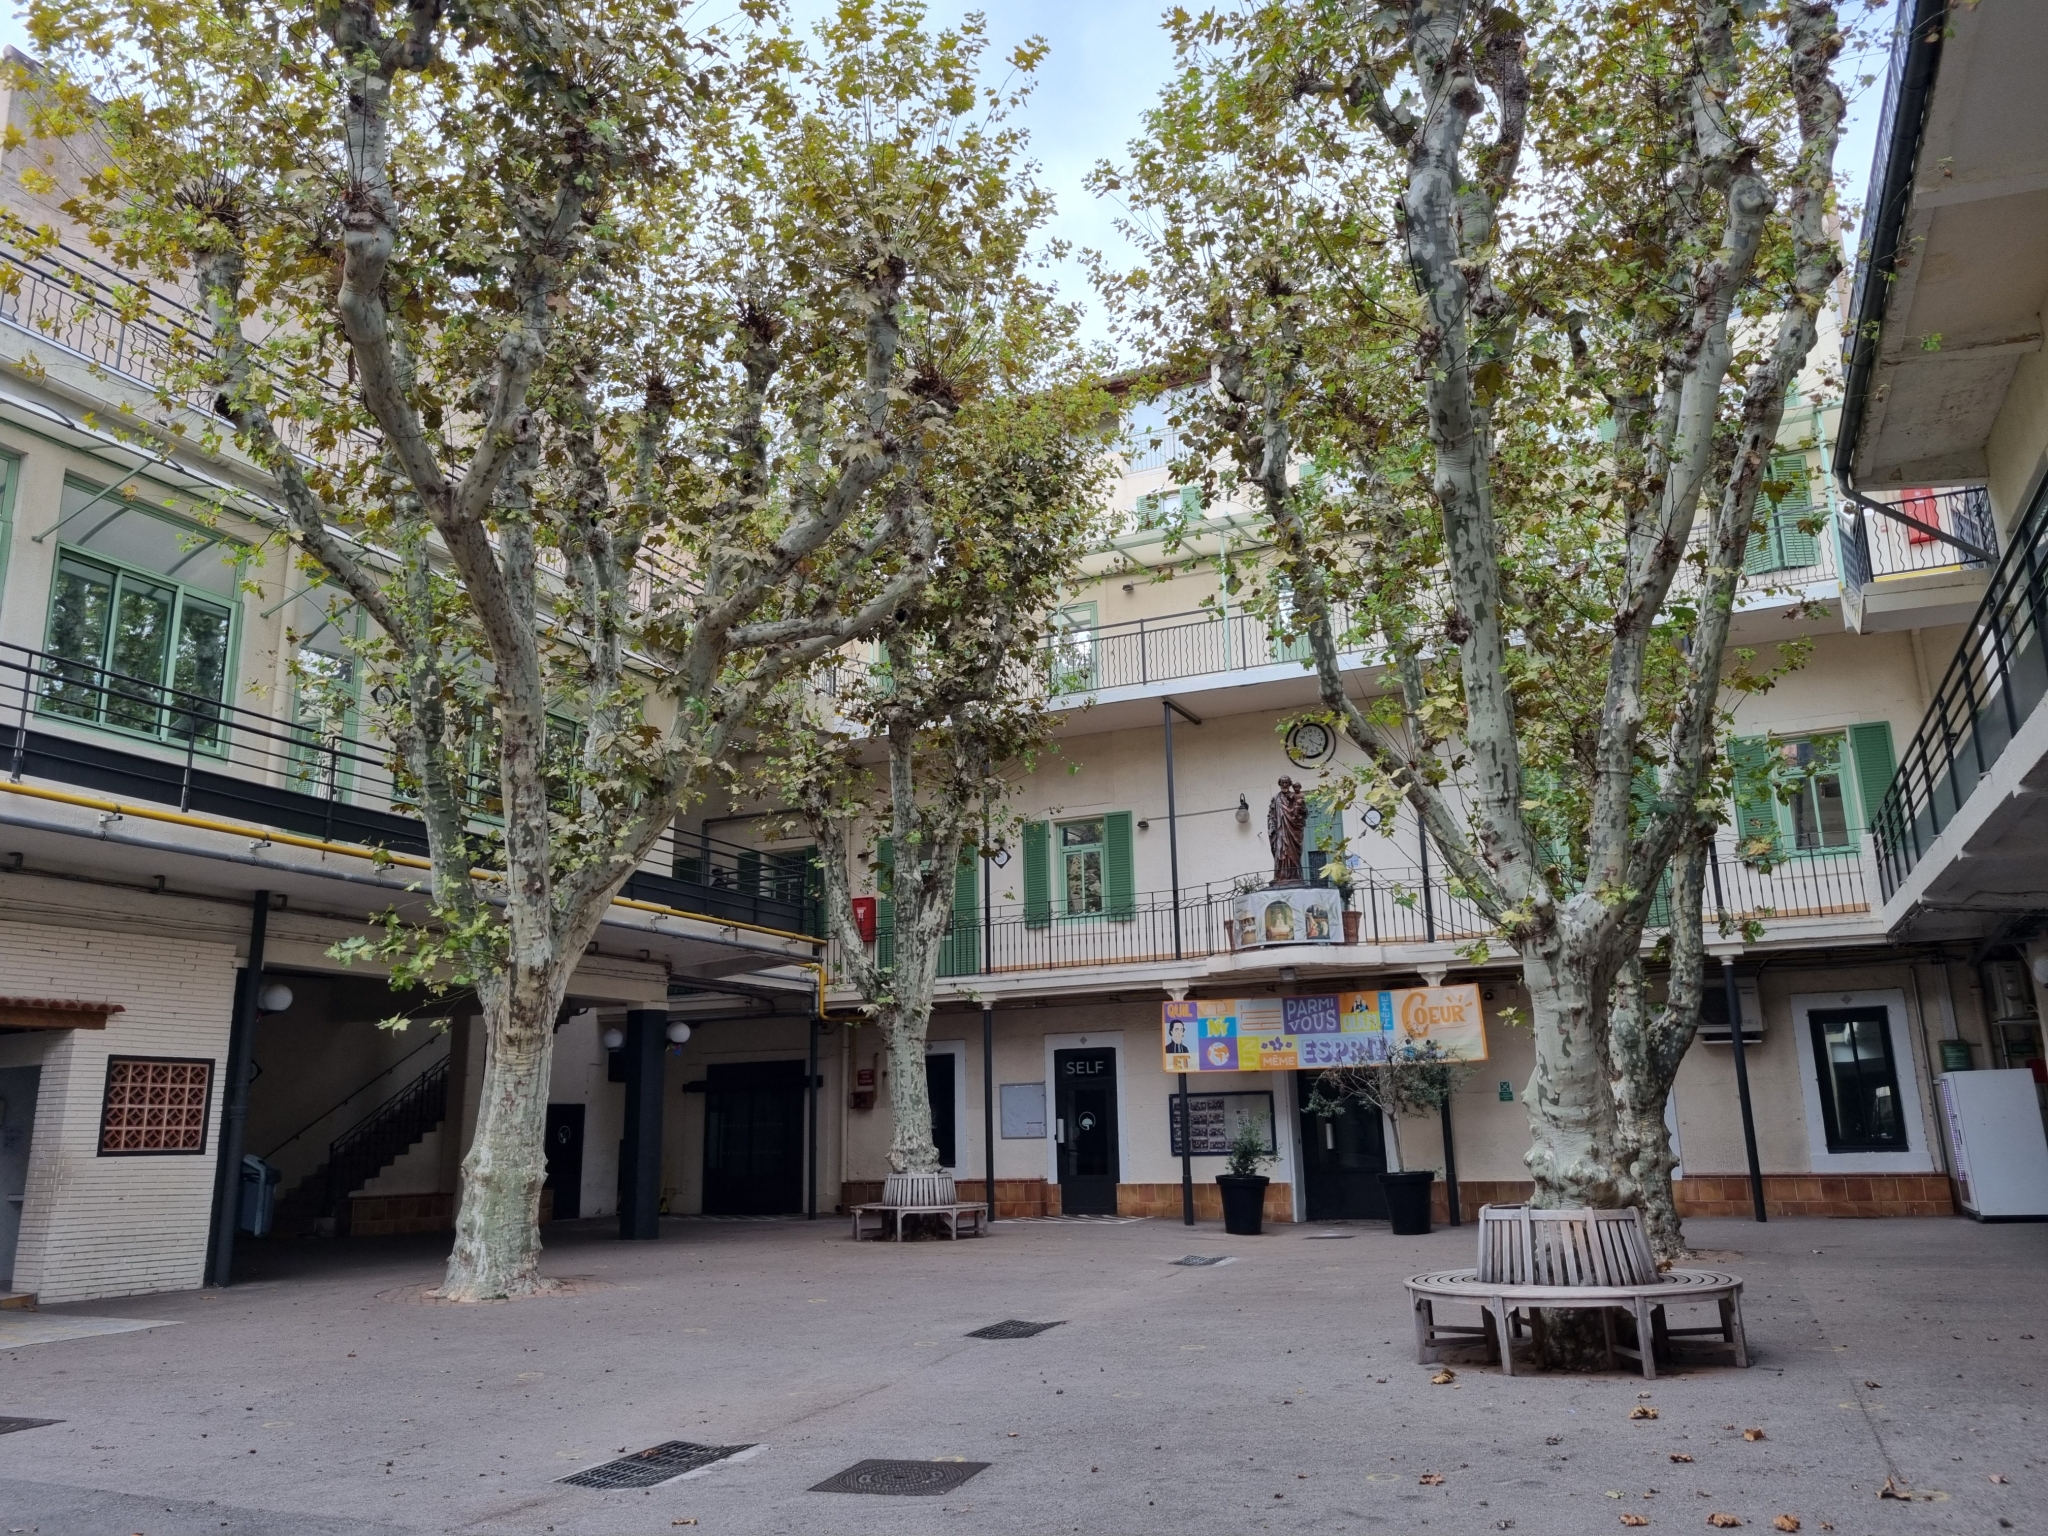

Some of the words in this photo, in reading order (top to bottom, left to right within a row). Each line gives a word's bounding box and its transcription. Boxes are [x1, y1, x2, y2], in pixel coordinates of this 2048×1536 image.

[1286, 998, 1334, 1020] PARMI
[1288, 1009, 1337, 1032] VOUS
[1381, 995, 1391, 1028] MÊME
[1401, 992, 1466, 1038] COEUR
[1242, 1039, 1257, 1066] UN
[1262, 1054, 1295, 1066] MÊME
[1302, 1036, 1388, 1063] ESPRIT
[1066, 1060, 1104, 1074] SELF
[1173, 1055, 1190, 1069] ET
